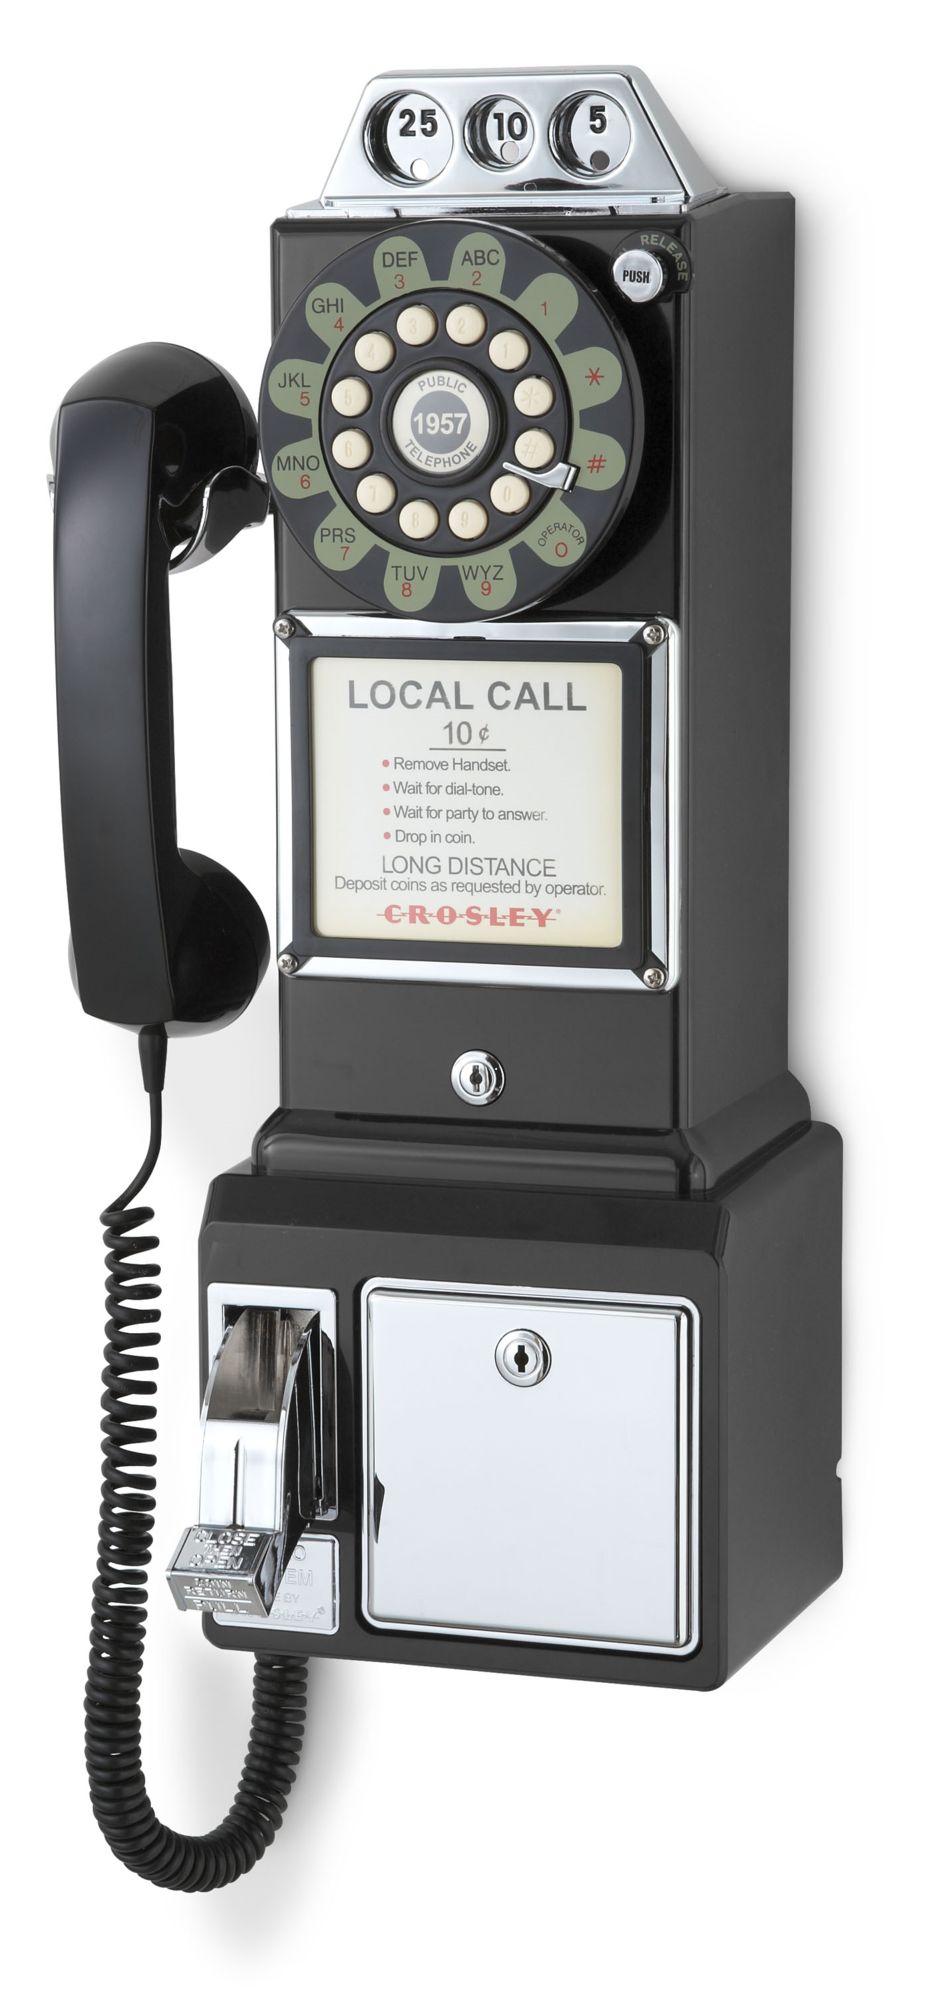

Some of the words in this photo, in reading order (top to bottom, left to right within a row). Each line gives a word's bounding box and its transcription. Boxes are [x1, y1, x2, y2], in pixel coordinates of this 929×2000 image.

[399, 108, 438, 137] 25
[492, 111, 528, 141] 10
[589, 104, 607, 134] 5
[383, 251, 418, 268] DEF
[461, 249, 499, 266] ABC
[640, 234, 689, 281] RELEASE
[394, 274, 405, 289] 3
[472, 271, 481, 285] 2
[622, 270, 650, 284] PUSH
[312, 298, 343, 313] GHI
[541, 302, 547, 316] 1
[334, 317, 344, 331] 4
[408, 318, 417, 335] 3
[457, 318, 466, 334] 2
[278, 373, 311, 388] JKL
[418, 375, 468, 393] PUBLIC
[300, 392, 310, 406] 5
[344, 389, 352, 406] 5
[414, 413, 467, 434] 1957
[344, 440, 353, 457] 6
[404, 439, 478, 468] TELEPHONE
[275, 454, 320, 471] MNO
[587, 454, 607, 473] #
[301, 474, 310, 489] 6
[321, 528, 355, 543] PRS
[537, 522, 585, 548] OPERATOR
[340, 546, 349, 560] 7
[391, 566, 428, 581] TUV
[462, 565, 503, 582] WYZ
[402, 582, 412, 597] 8
[481, 581, 491, 596] 9
[349, 680, 474, 709] LOCAL
[488, 681, 587, 711] CALL
[444, 721, 472, 745] 10
[394, 757, 449, 770] Remove
[453, 758, 510, 771] Handset.
[393, 781, 422, 794] Wait
[424, 781, 443, 795] for
[446, 782, 503, 796] dial-tone.
[394, 806, 423, 818] Wait
[426, 805, 444, 820] for
[445, 807, 480, 824] party
[481, 807, 495, 821] to
[497, 810, 549, 822] answer.
[396, 830, 427, 846] Drop
[430, 829, 442, 844] in
[445, 832, 475, 844] coin.
[383, 856, 441, 874] LONG
[449, 857, 556, 877] DISTANCE
[335, 876, 387, 893] Deposit
[391, 878, 427, 891] coins
[430, 880, 447, 892] as
[452, 880, 520, 896] requested
[524, 880, 541, 898] by
[544, 883, 607, 898] operator.
[195, 1530, 260, 1546] CLOSE
[190, 1554, 244, 1569] OPEN
[193, 1600, 248, 1613] PULL
